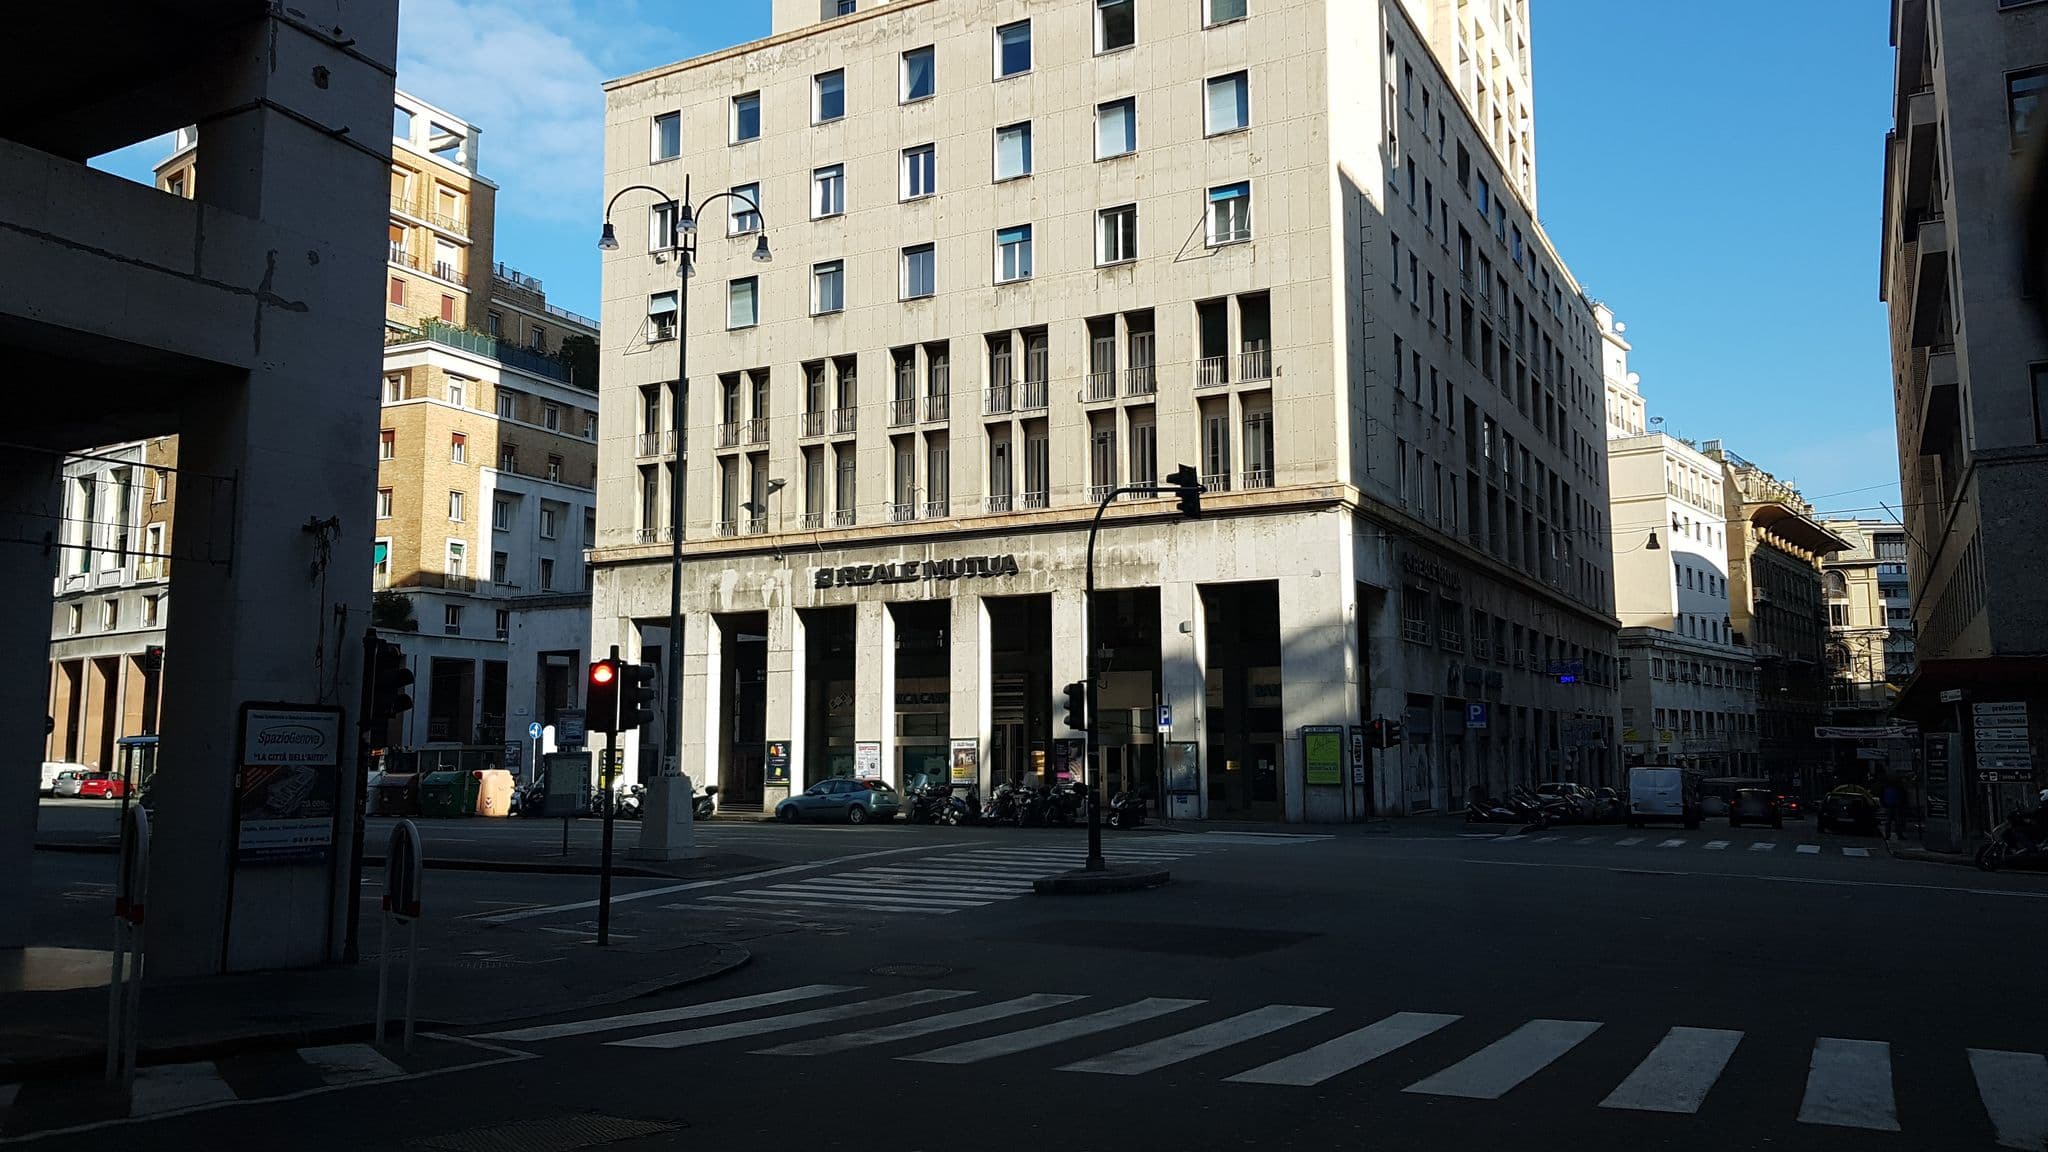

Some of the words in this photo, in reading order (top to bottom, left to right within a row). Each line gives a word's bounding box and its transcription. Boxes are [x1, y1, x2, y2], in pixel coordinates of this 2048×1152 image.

[836, 560, 921, 587] REALE
[922, 554, 1019, 580] MUTUA
[1161, 709, 1168, 724] P
[1469, 705, 1481, 720] P
